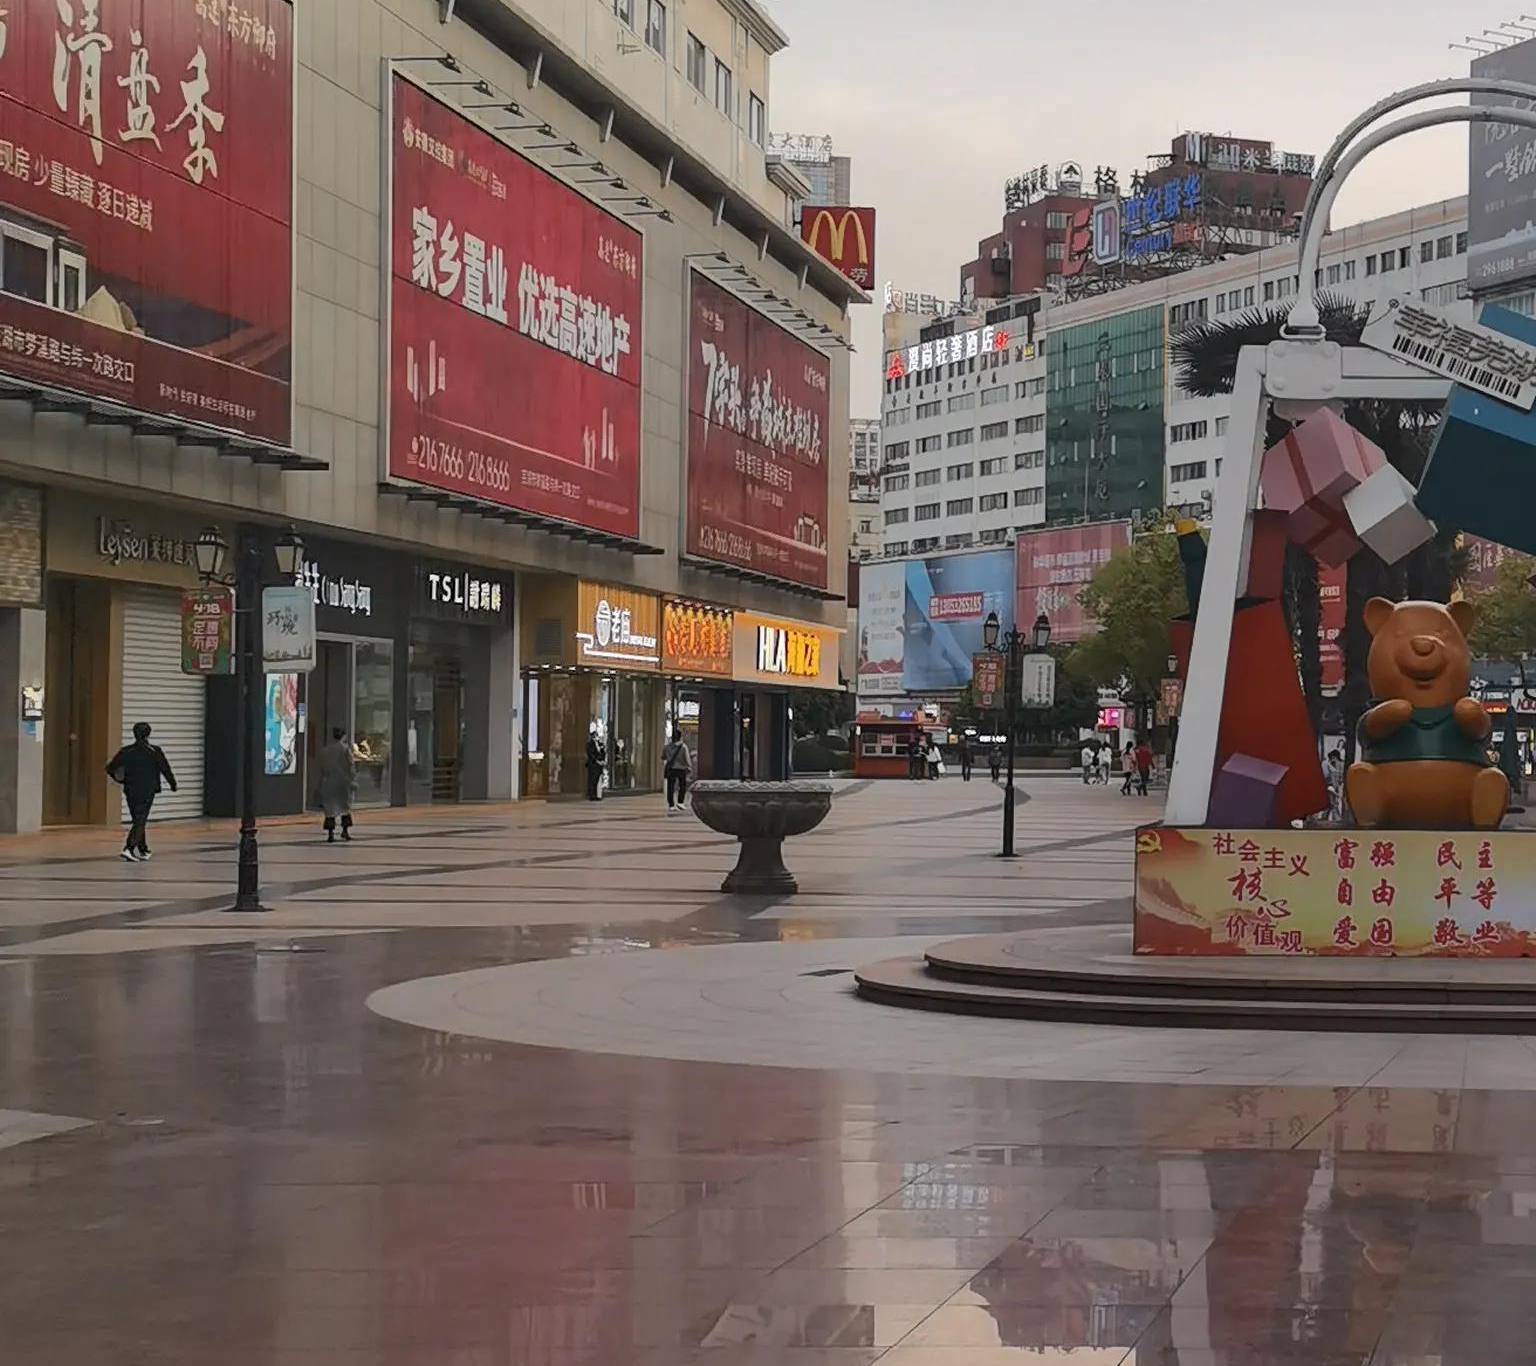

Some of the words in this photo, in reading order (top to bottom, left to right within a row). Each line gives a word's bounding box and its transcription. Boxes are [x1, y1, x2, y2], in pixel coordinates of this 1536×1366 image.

[412, 206, 508, 325] 家乡置业
[518, 262, 631, 376] 优选高速地产
[429, 573, 463, 604] TSL
[758, 625, 787, 673] HLA
[1213, 832, 1310, 877] 社会主义
[1333, 838, 1396, 870] 富强
[1437, 840, 1493, 870] 民主
[1227, 867, 1292, 919] 核心
[1337, 877, 1396, 907] 自由
[1434, 878, 1498, 910] 平等
[1225, 914, 1304, 953] 价值观
[1333, 916, 1393, 947] 爱国
[1433, 918, 1500, 947] 敬业
